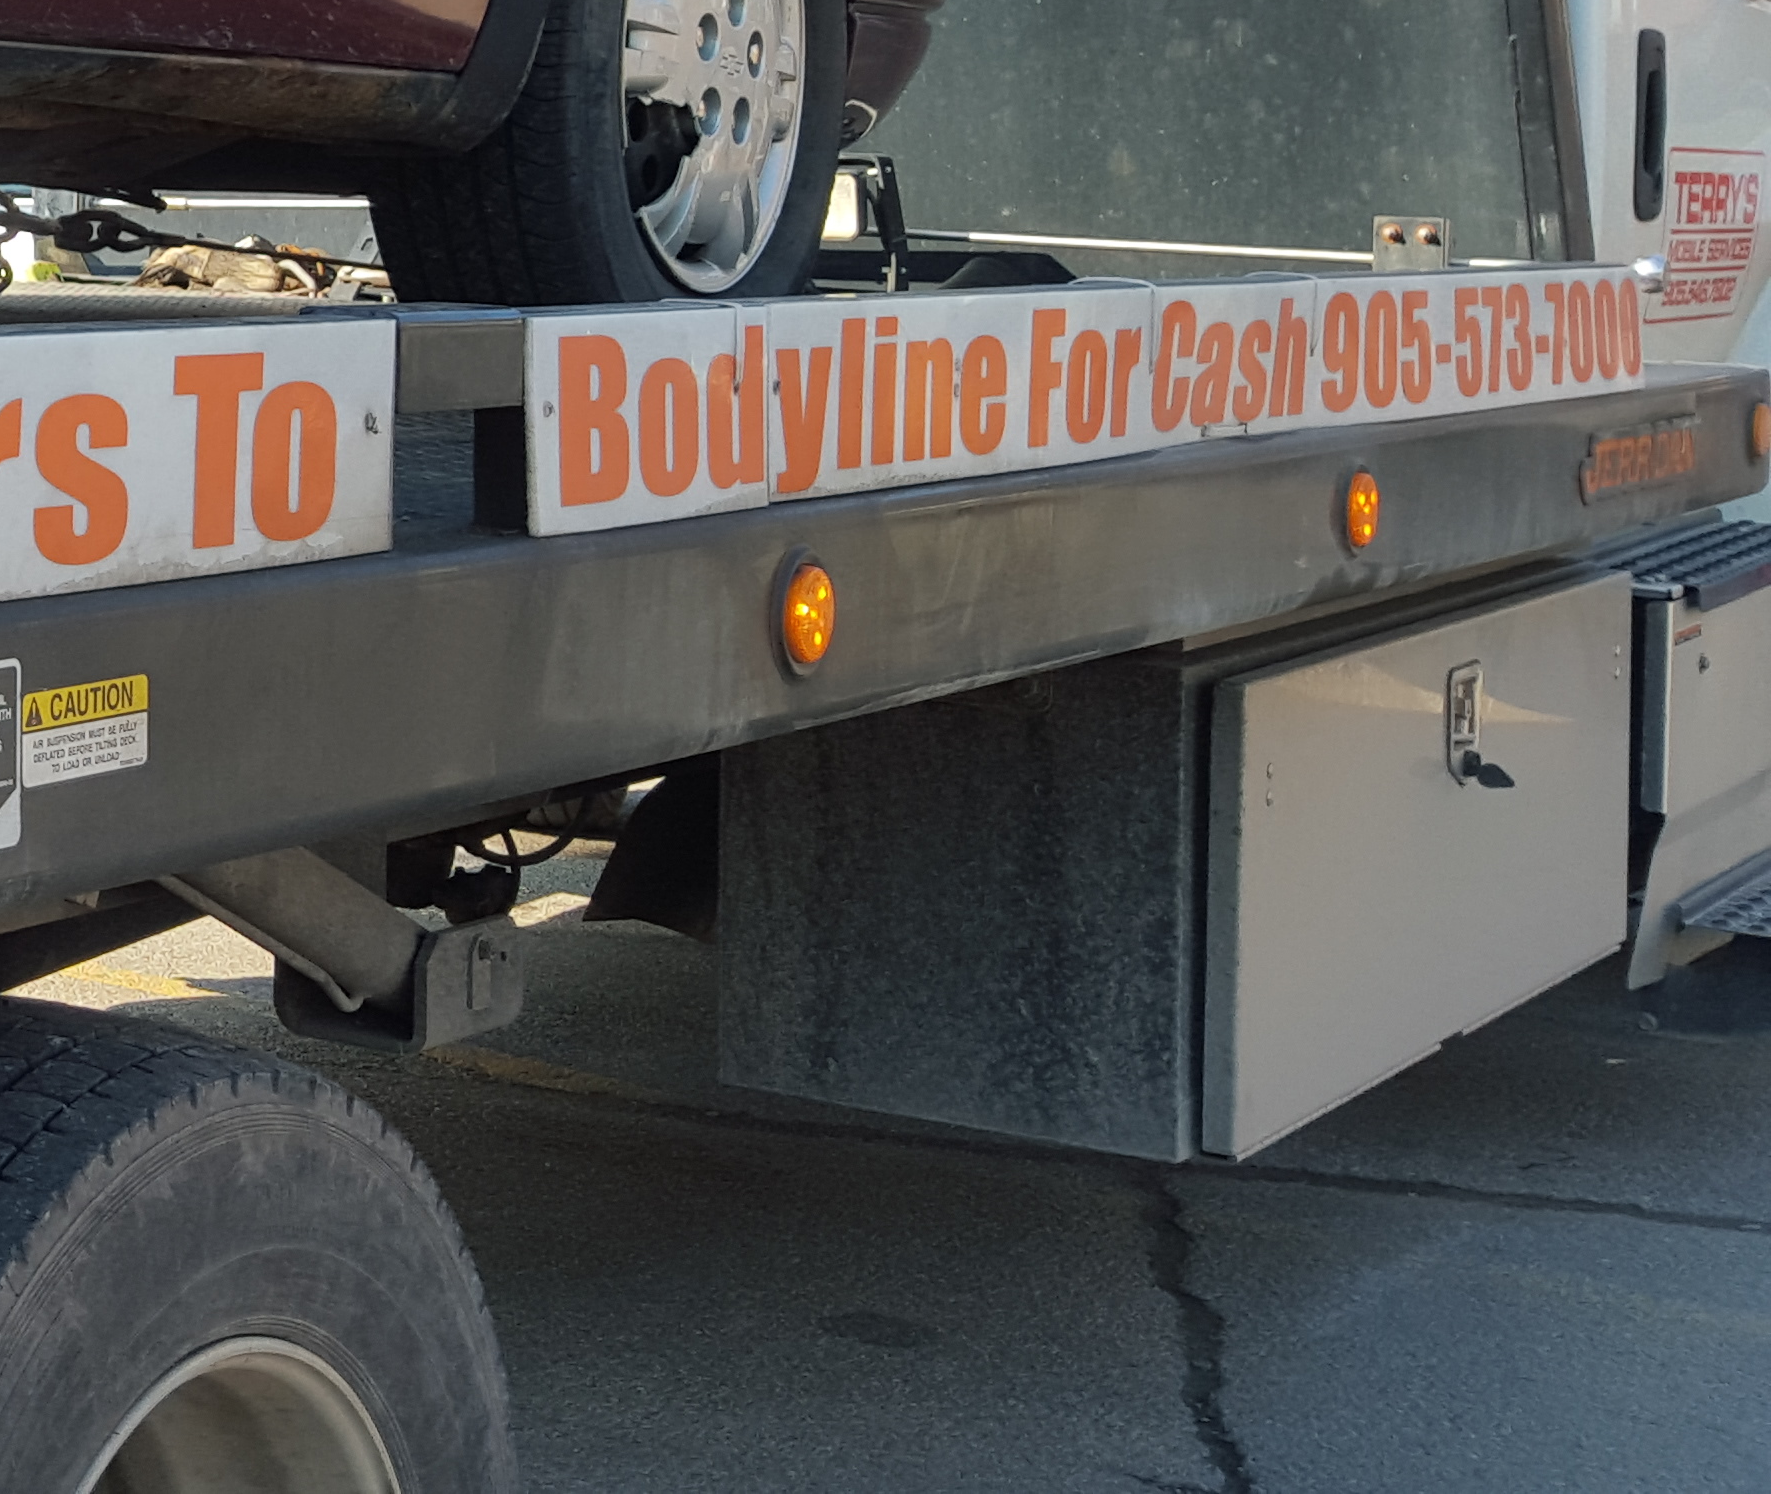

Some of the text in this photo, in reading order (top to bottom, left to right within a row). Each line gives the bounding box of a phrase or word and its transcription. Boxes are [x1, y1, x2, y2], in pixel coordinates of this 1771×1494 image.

[174, 352, 337, 549] To
[560, 277, 1642, 505] Bodyline For Cash 905-573-7000
[50, 680, 134, 721] CAUTION
